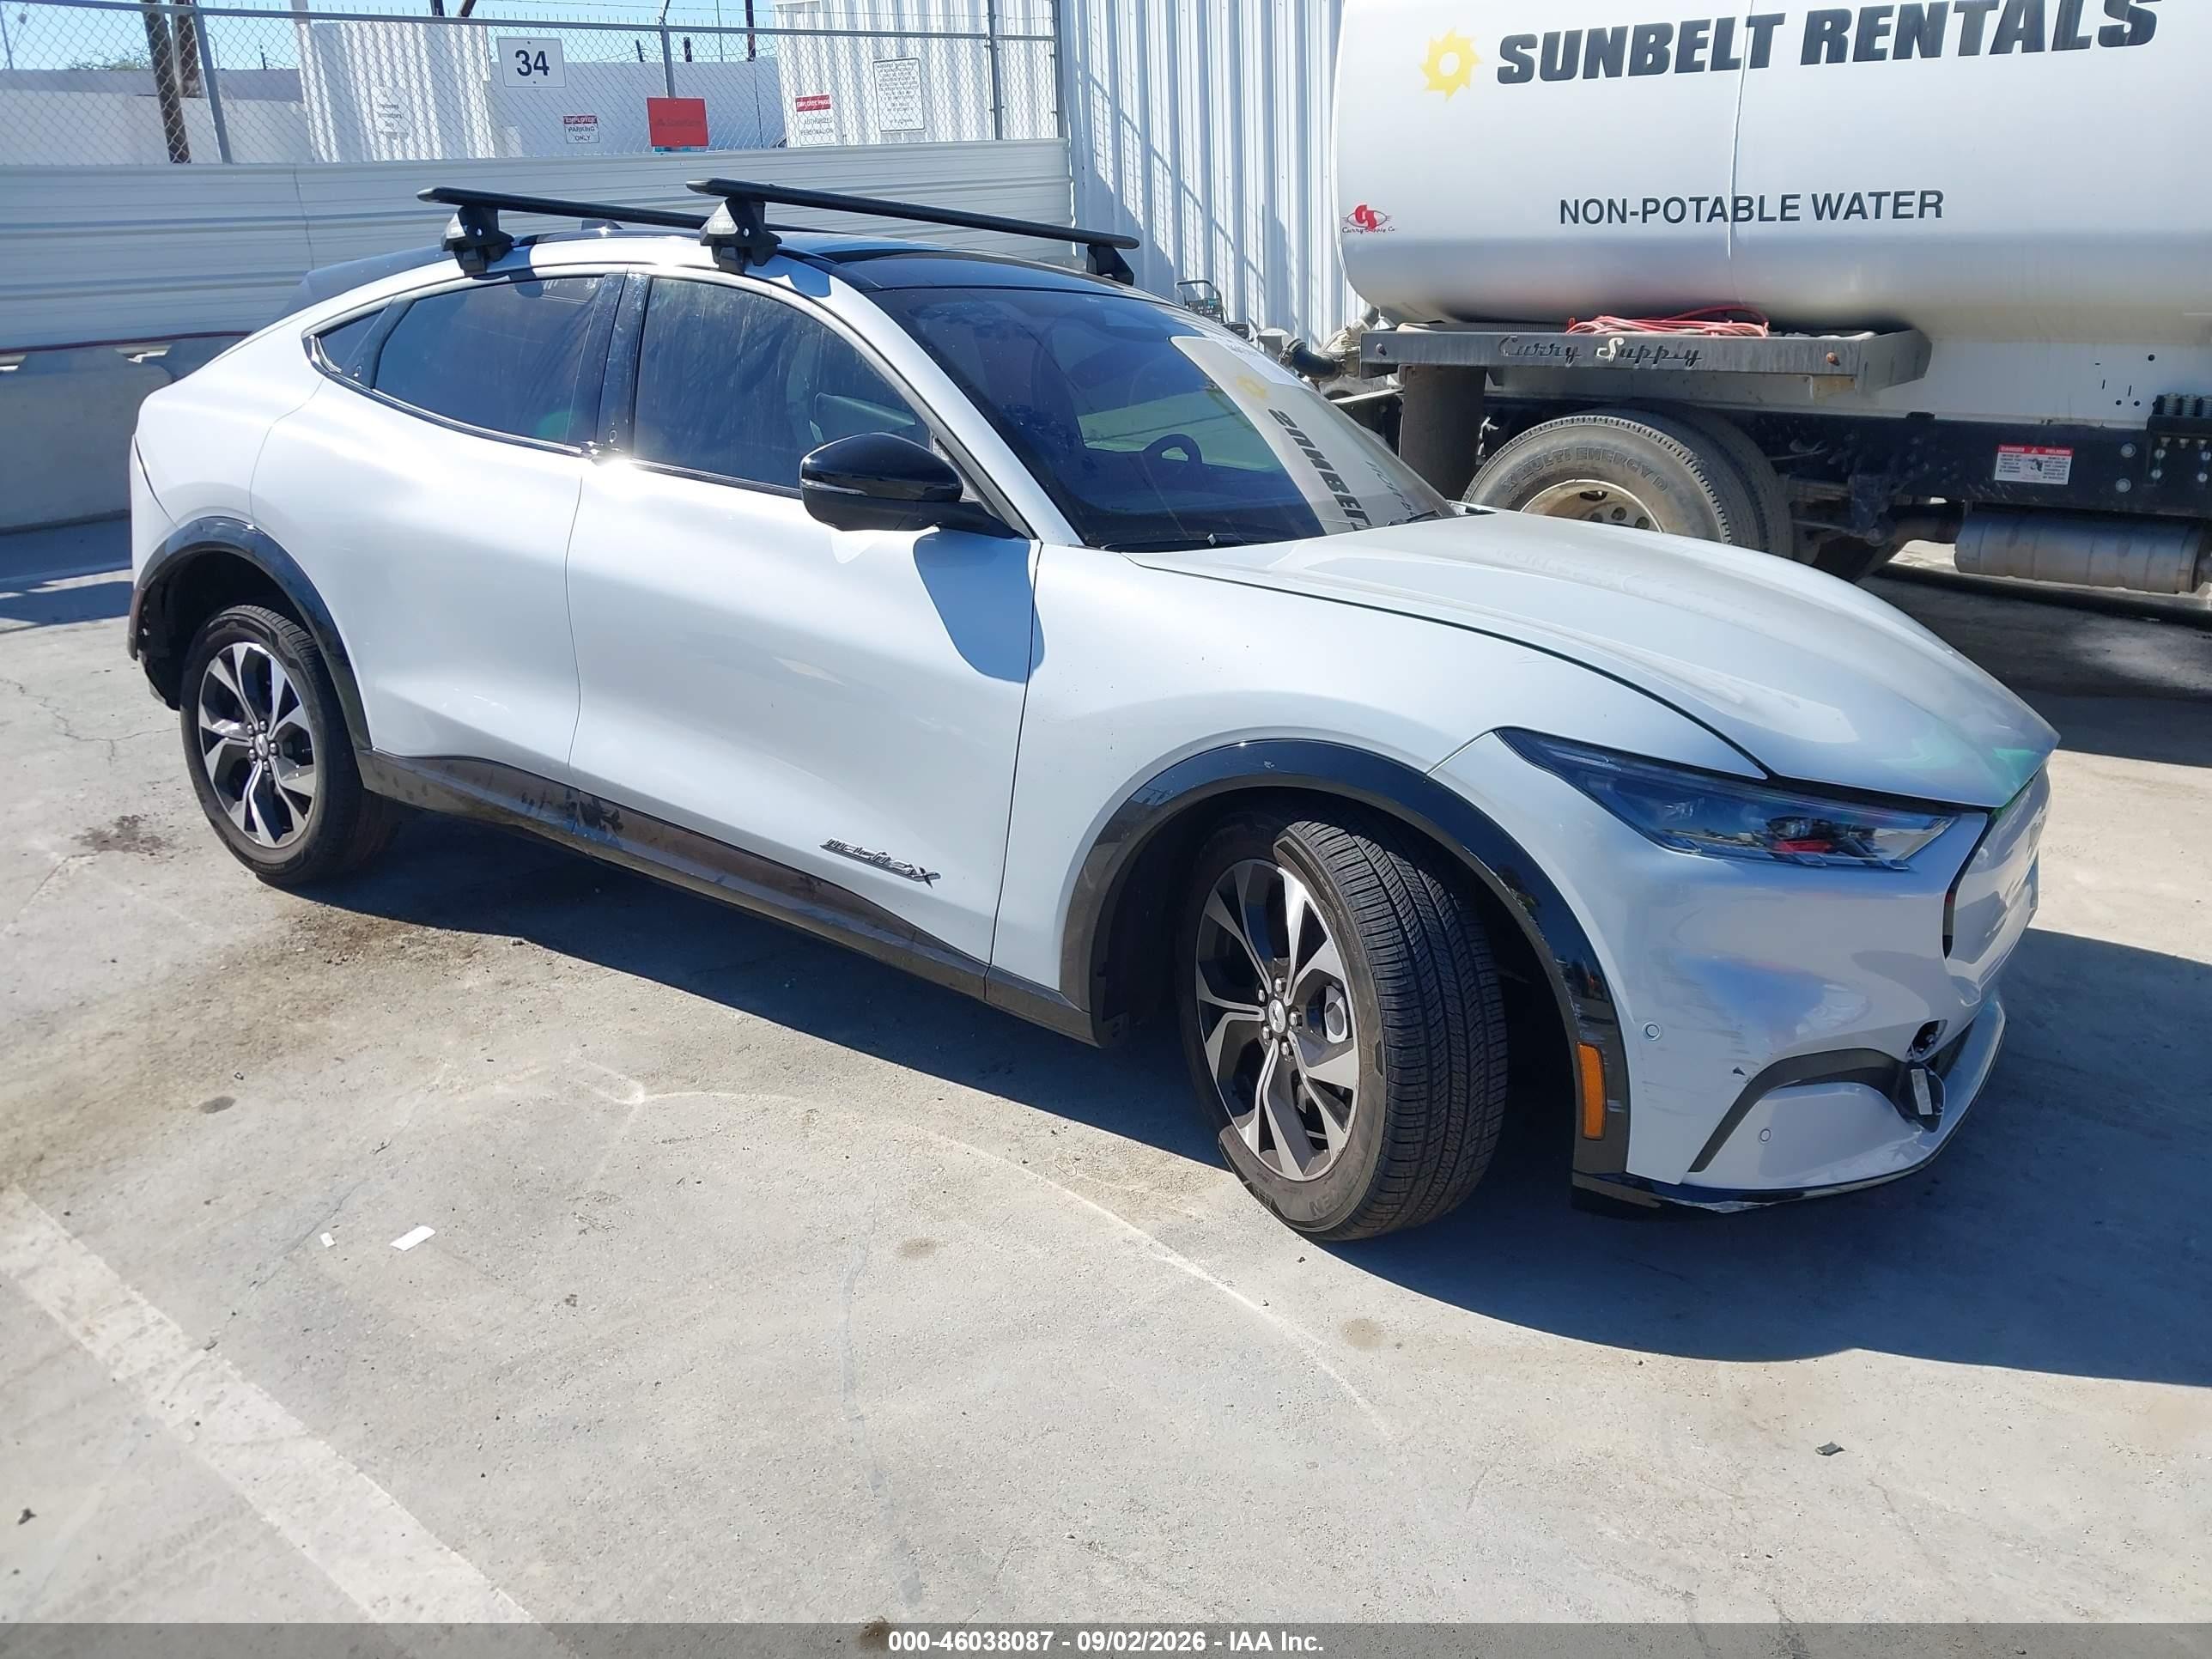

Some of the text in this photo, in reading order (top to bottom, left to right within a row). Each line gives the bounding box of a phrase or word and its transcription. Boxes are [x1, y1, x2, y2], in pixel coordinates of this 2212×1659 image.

[1498, 0, 2161, 84] SUNBELT RENTALS
[515, 50, 550, 76] 34
[1560, 190, 1945, 225] NON-POTABLE WATER
[1498, 335, 1702, 368] Curry Supply
[1516, 447, 1571, 481] MULTI
[1575, 446, 1654, 479] ENERGY
